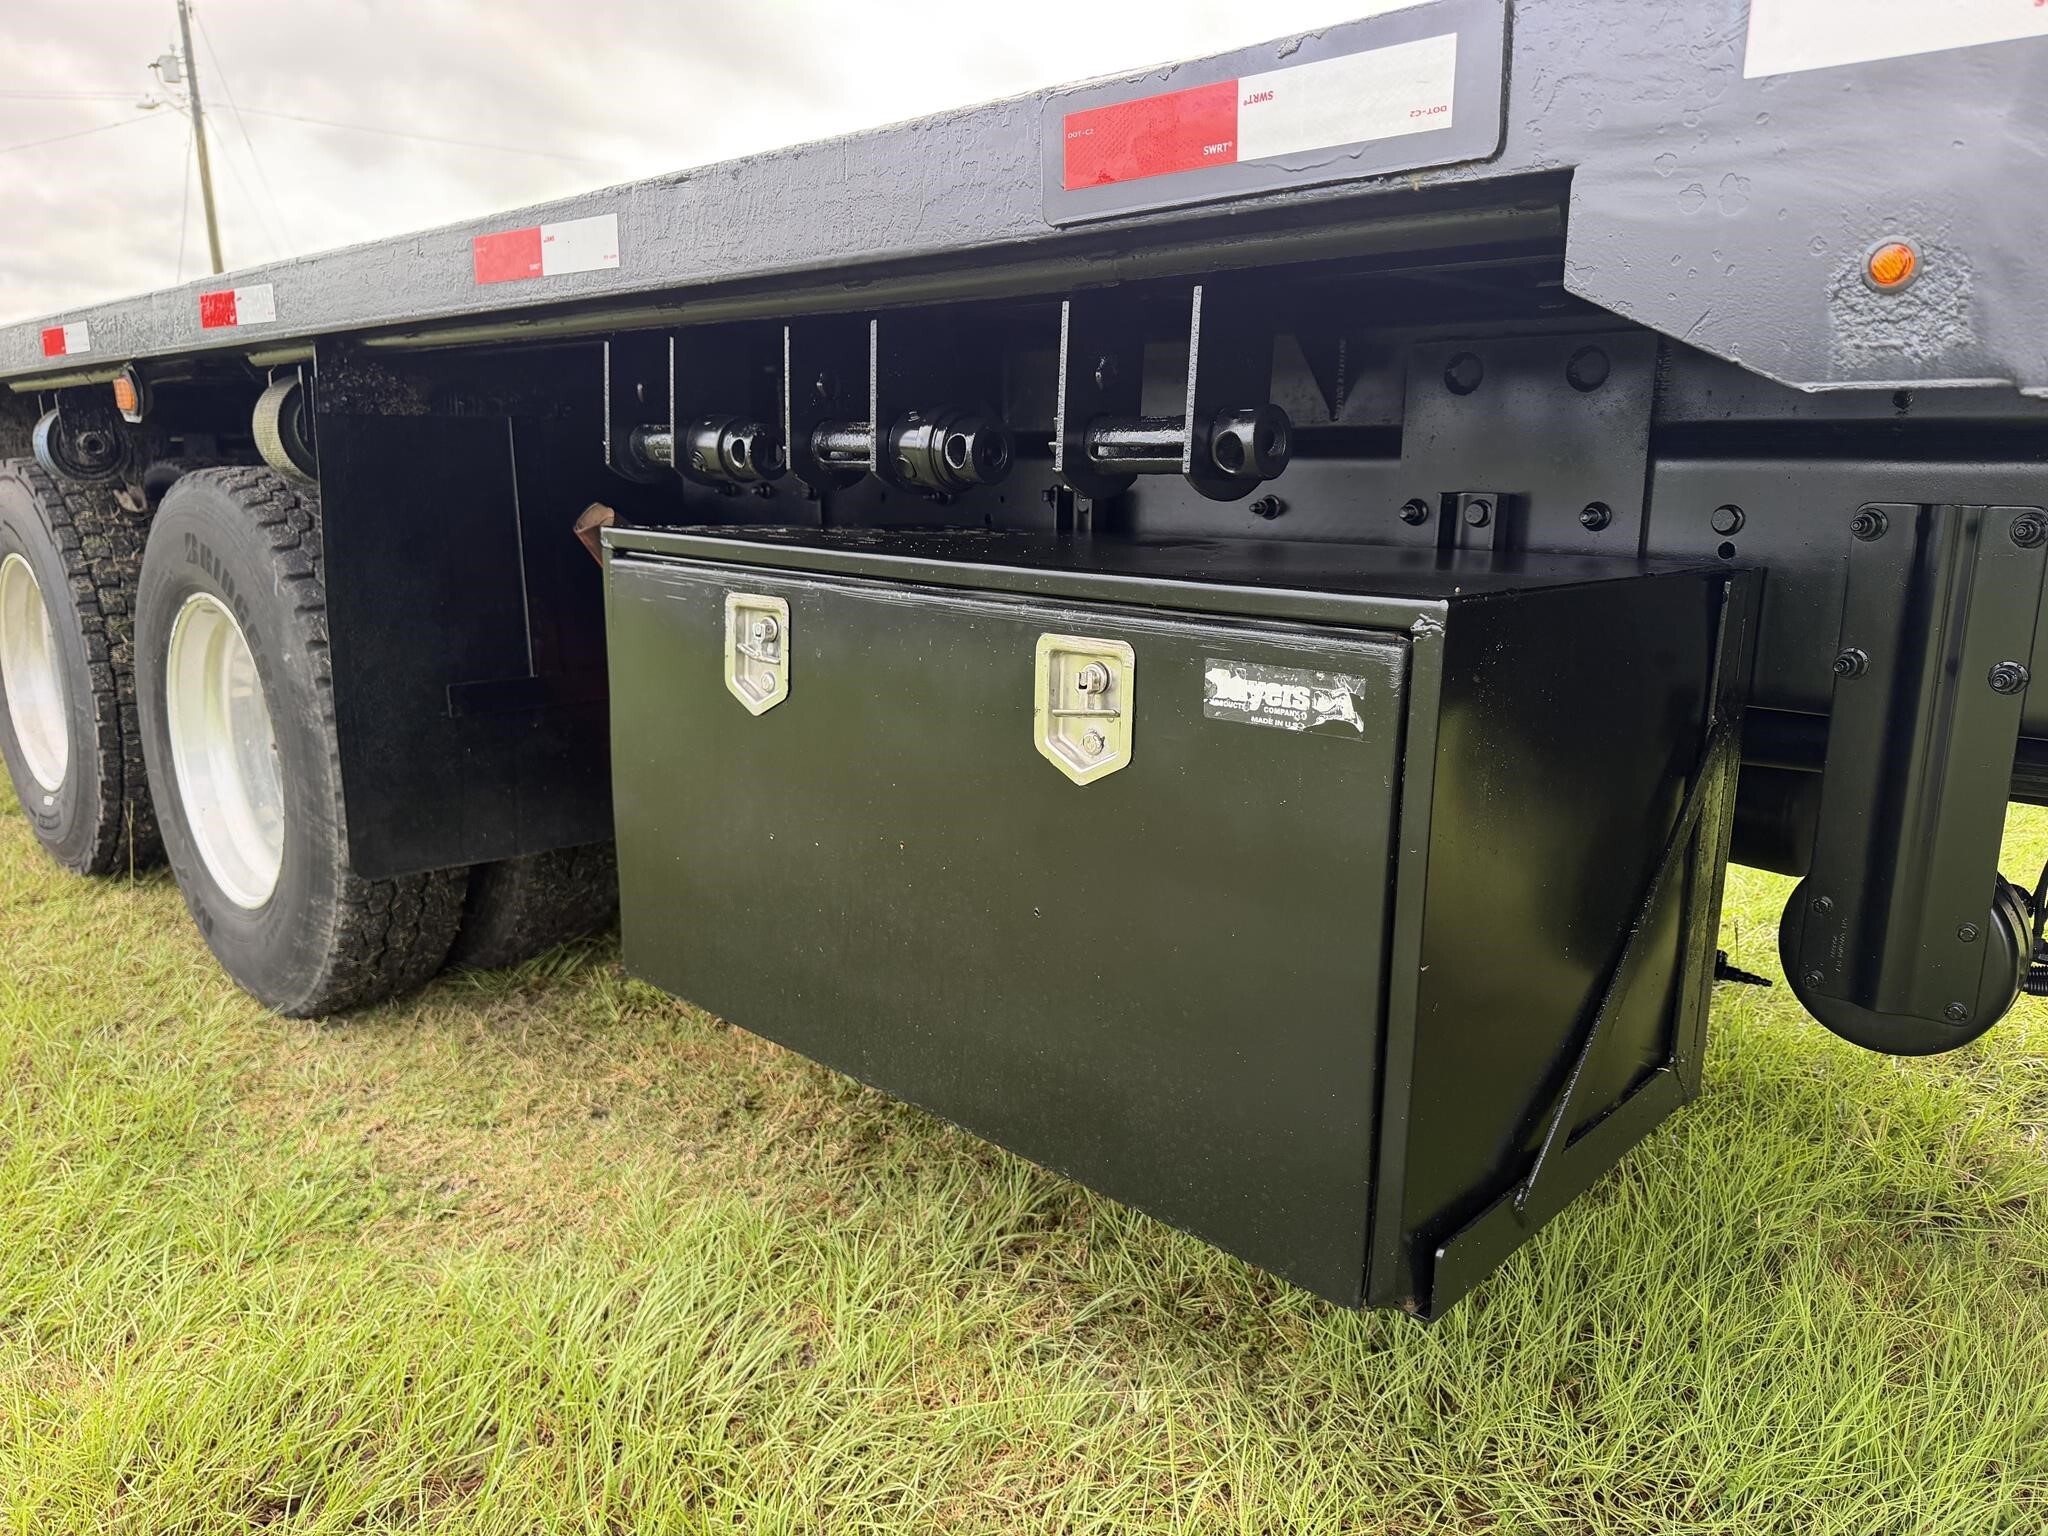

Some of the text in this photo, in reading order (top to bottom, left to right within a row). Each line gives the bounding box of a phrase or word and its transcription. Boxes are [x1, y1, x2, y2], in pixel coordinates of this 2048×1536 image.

[1410, 105, 1447, 117] DOT-C2
[1067, 128, 1094, 139] DOT-C2
[1250, 716, 1274, 726] MADE
[1274, 719, 1284, 727] IN
